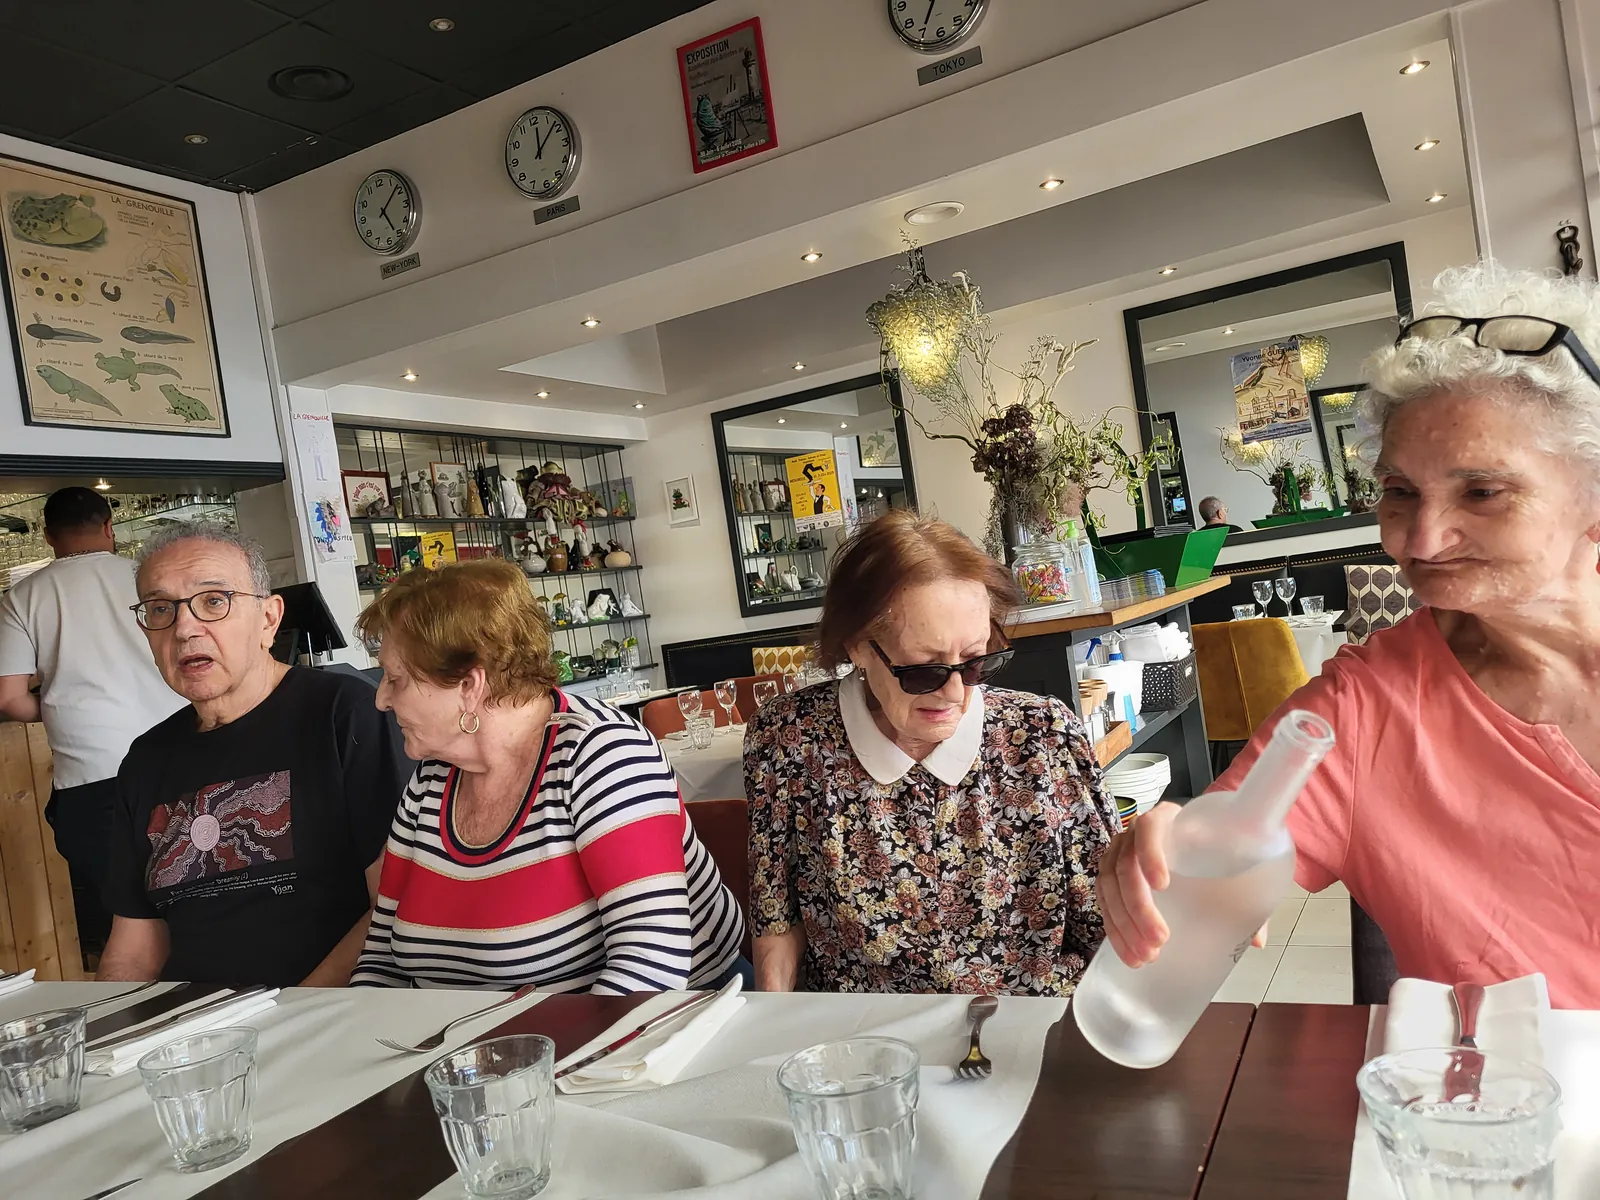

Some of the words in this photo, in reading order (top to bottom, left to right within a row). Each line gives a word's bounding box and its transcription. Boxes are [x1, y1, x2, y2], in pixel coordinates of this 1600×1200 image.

[898, 1, 906, 12] 9
[905, 18, 914, 28] 8
[953, 15, 962, 26] 5
[919, 28, 926, 38] 7
[936, 27, 945, 37] 6
[686, 39, 729, 65] EXPOSITION
[933, 57, 965, 75] TOKYO
[529, 116, 538, 126] 12
[520, 126, 526, 135] 11
[555, 124, 562, 132] 2
[512, 140, 520, 150] 10
[562, 138, 569, 146] 3
[512, 159, 519, 167] 9
[561, 155, 568, 164] 4
[519, 173, 526, 181] 8
[555, 171, 562, 179] 5
[375, 179, 384, 188] 12
[530, 180, 536, 189] 7
[367, 187, 372, 195] 11
[111, 196, 121, 204] LA
[126, 200, 174, 217] GRENOUILLE
[361, 200, 367, 209] 10
[547, 204, 566, 218] PARIS
[383, 258, 417, 275] NEW-YORK
[1242, 354, 1265, 362] Yvonne
[271, 884, 293, 896] Yijan
